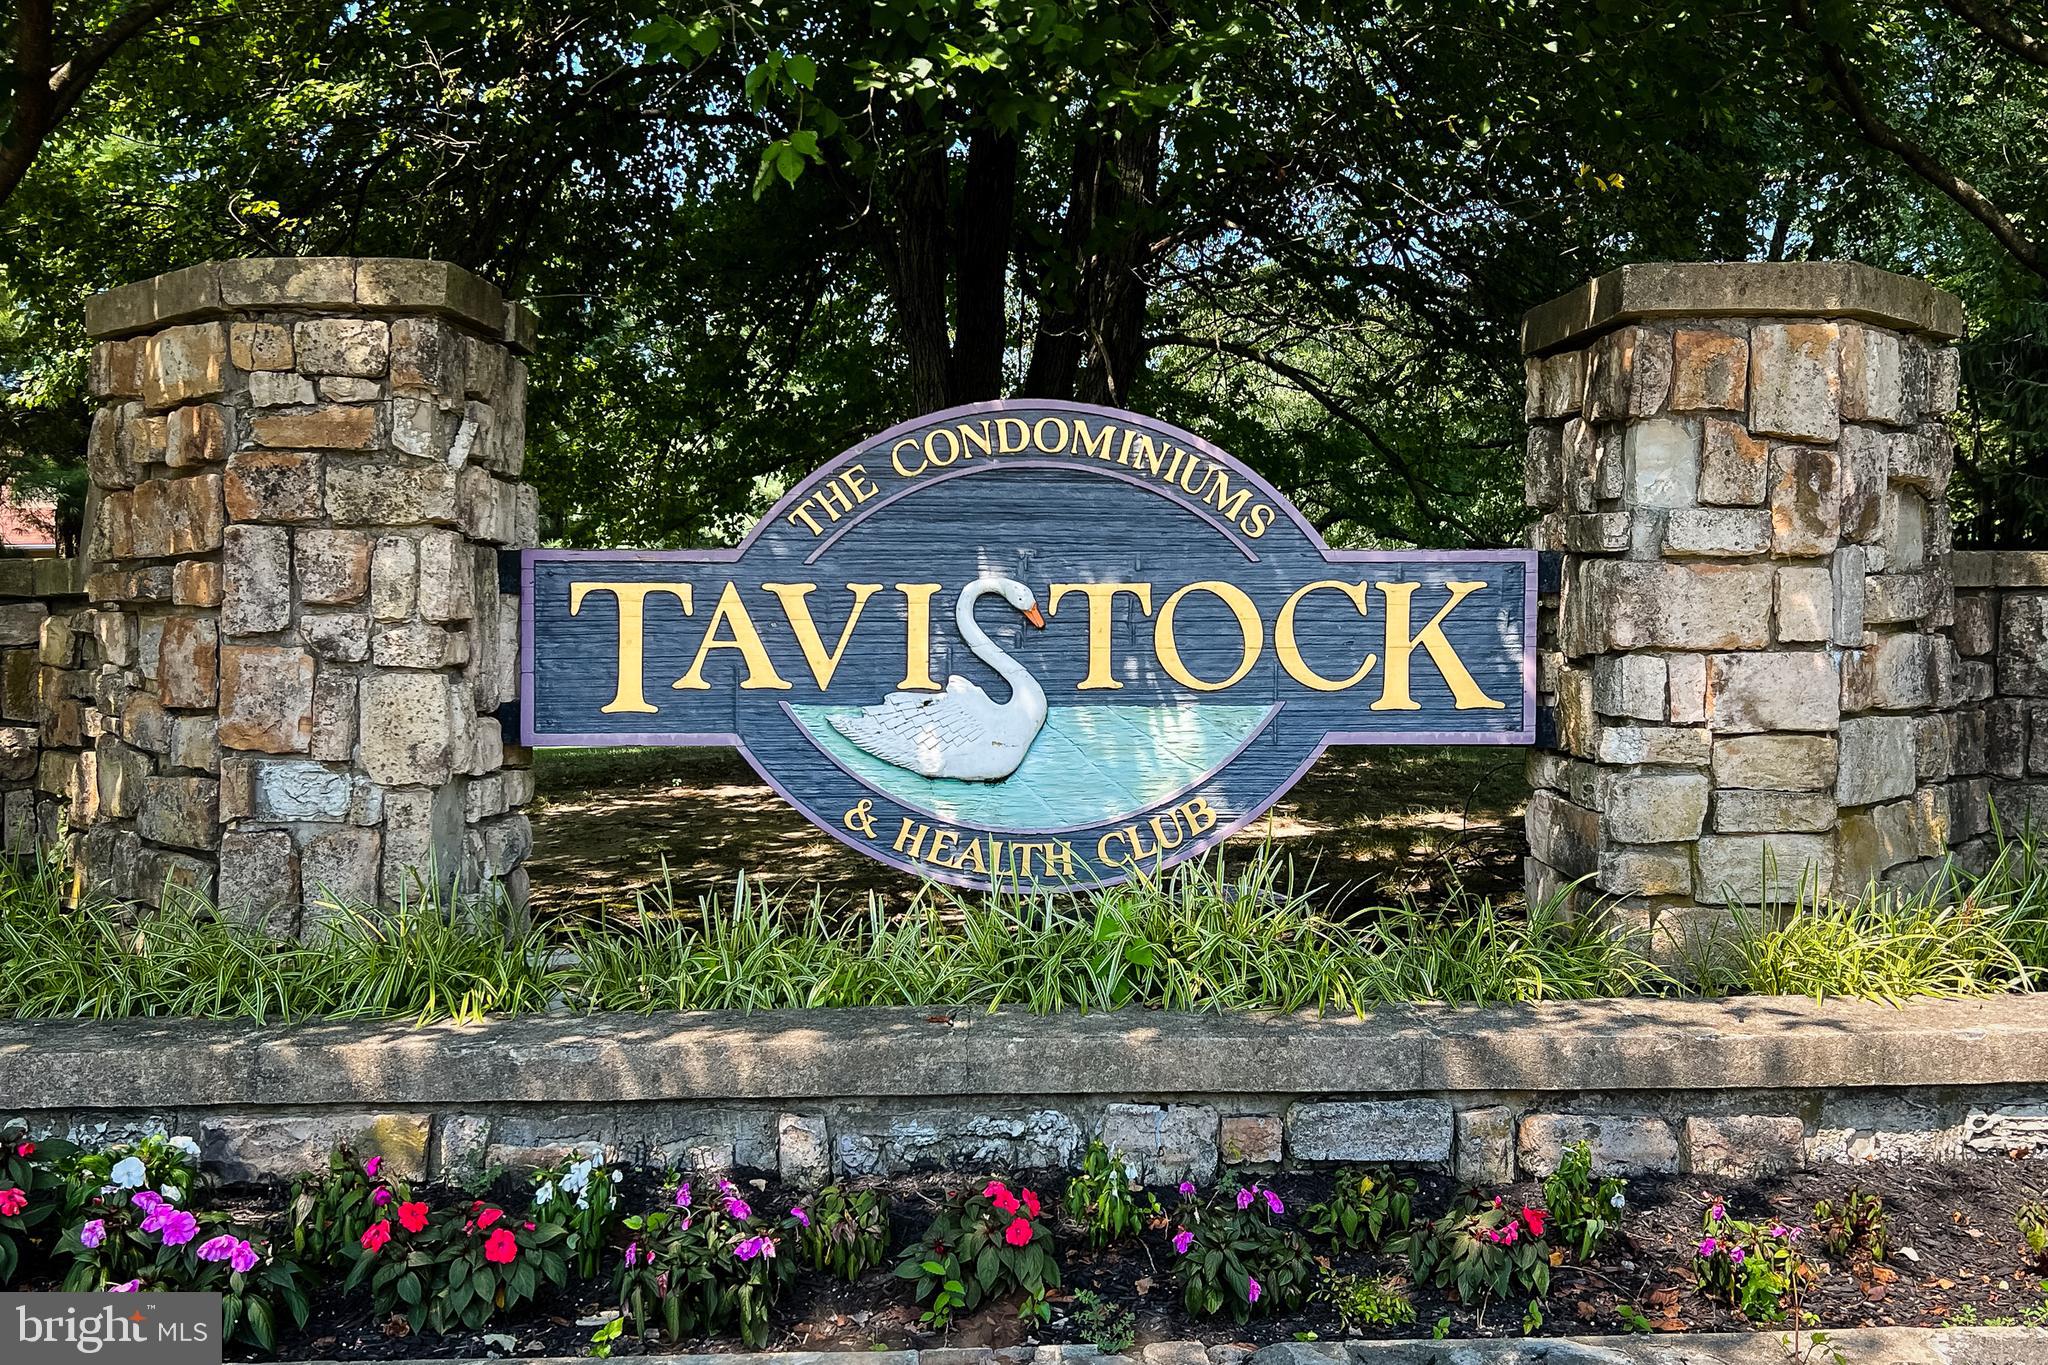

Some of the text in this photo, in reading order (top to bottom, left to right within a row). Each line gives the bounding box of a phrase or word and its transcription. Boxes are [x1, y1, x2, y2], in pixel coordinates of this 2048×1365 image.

[787, 417, 1277, 539] THE CONDOMINIUMS
[570, 577, 1506, 715] TAVISTOCK
[845, 797, 1217, 878] & HEALTH CLUB
